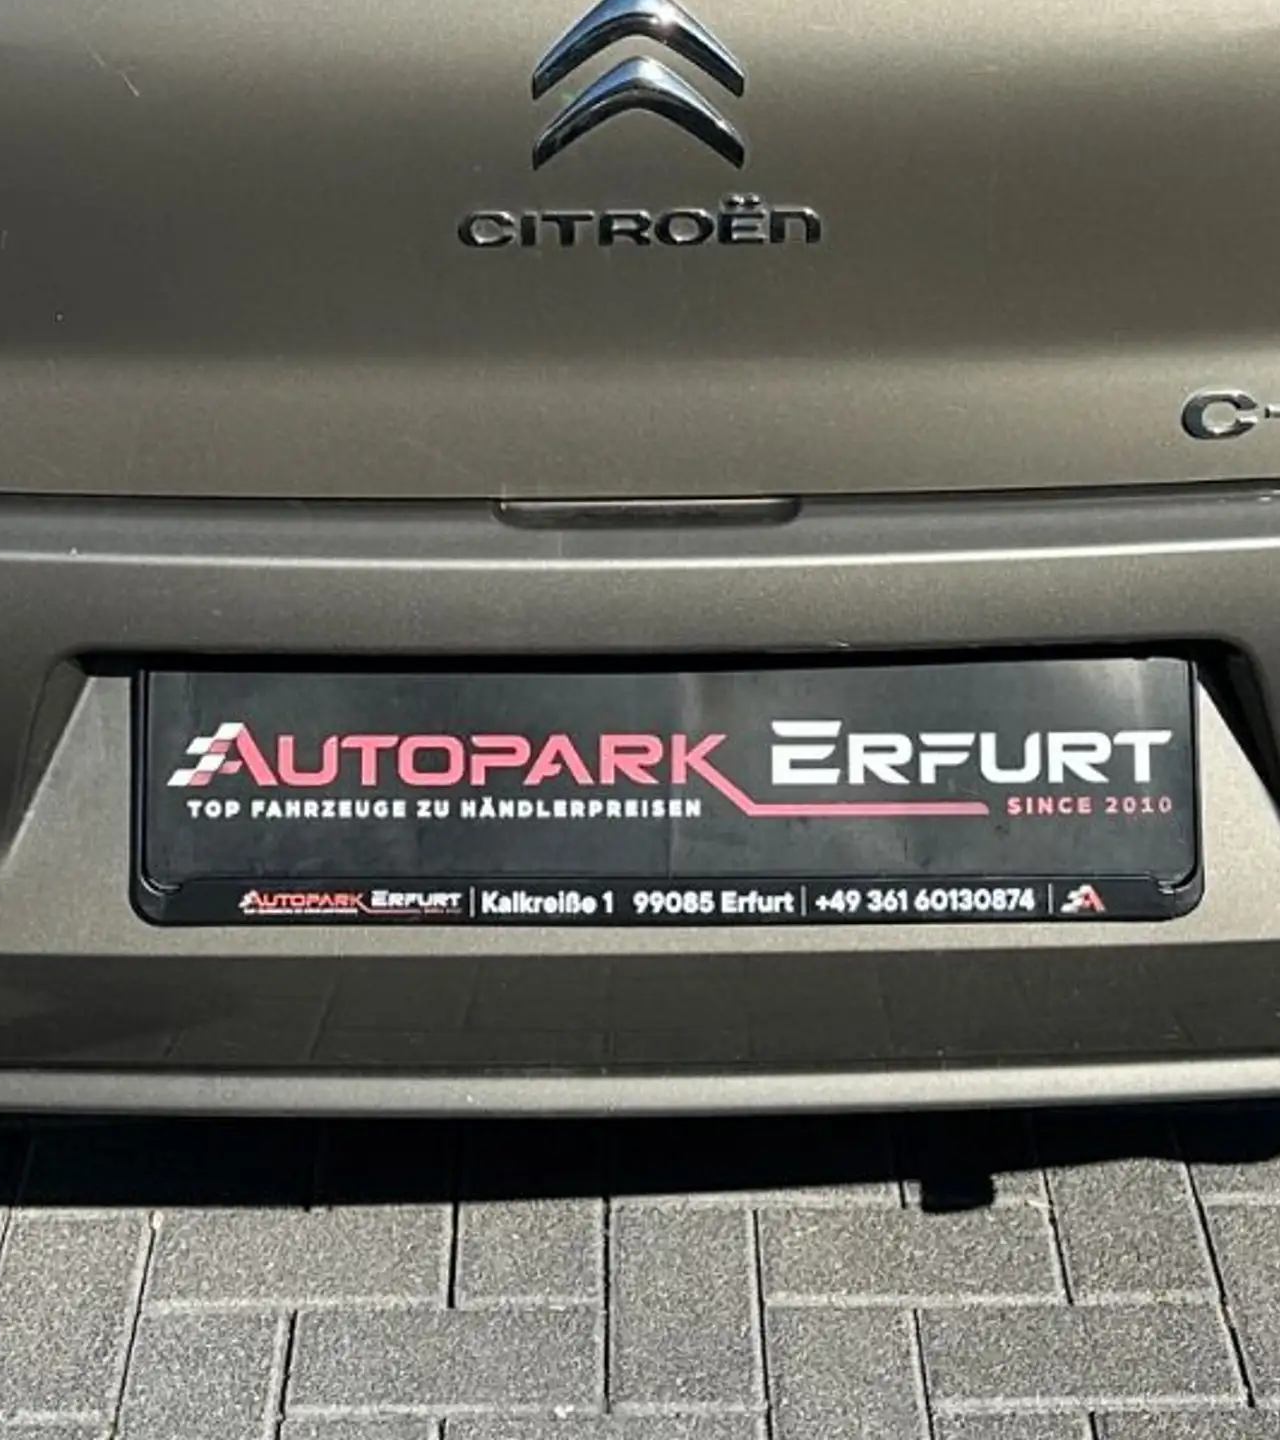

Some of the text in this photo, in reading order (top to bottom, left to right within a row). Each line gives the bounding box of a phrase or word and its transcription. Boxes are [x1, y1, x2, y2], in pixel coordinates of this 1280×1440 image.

[167, 720, 1173, 787] AUTOPARK ERFURT
[186, 796, 703, 819] TOP FAHRZEUGE ZU HÄNDLERPREISEN
[1006, 795, 1173, 816] SINCE 2010
[238, 889, 364, 908] AUTOPARK
[370, 889, 463, 908] ERFURT
[481, 890, 598, 914] Kalkreiße
[602, 891, 614, 913] 1
[632, 890, 716, 914] 99085
[721, 890, 795, 914] Erfurt
[815, 889, 861, 912] +49
[867, 889, 908, 912] 361
[914, 887, 1035, 912] 60130874
